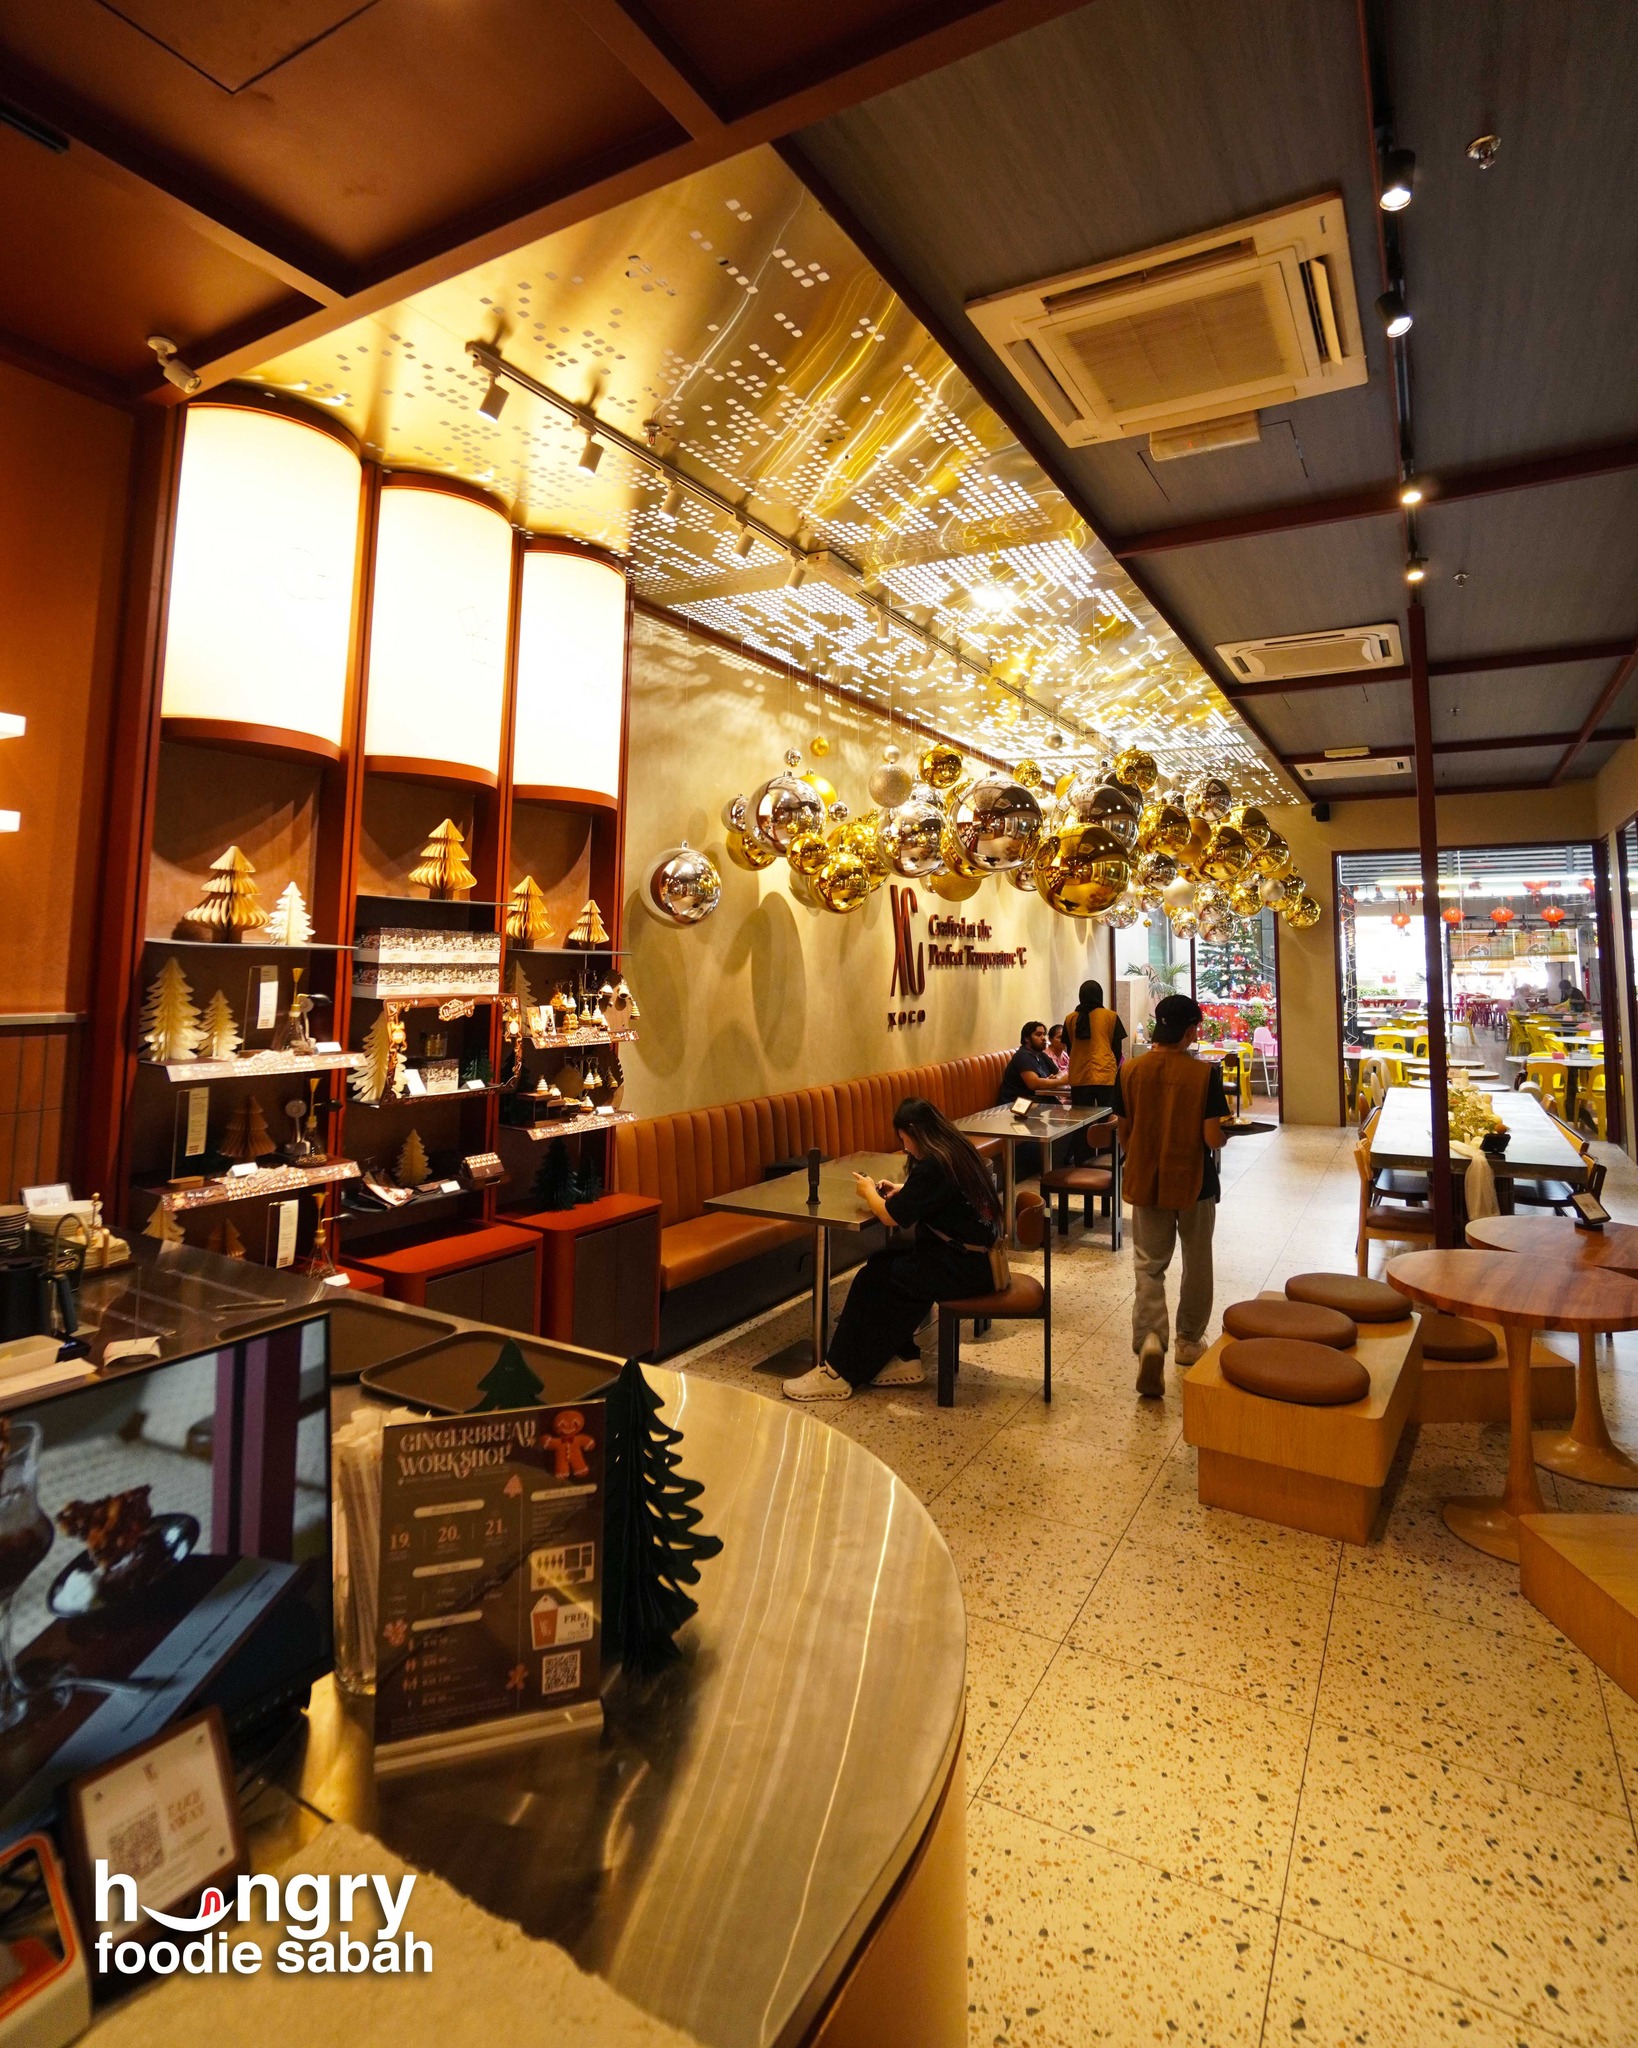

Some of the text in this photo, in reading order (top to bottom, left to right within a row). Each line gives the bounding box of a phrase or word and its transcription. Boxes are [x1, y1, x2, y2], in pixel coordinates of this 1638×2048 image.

[928, 944, 964, 966] Perfect
[399, 1419, 537, 1454] GINGERBREAD
[397, 1442, 513, 1480] WORKSHOP
